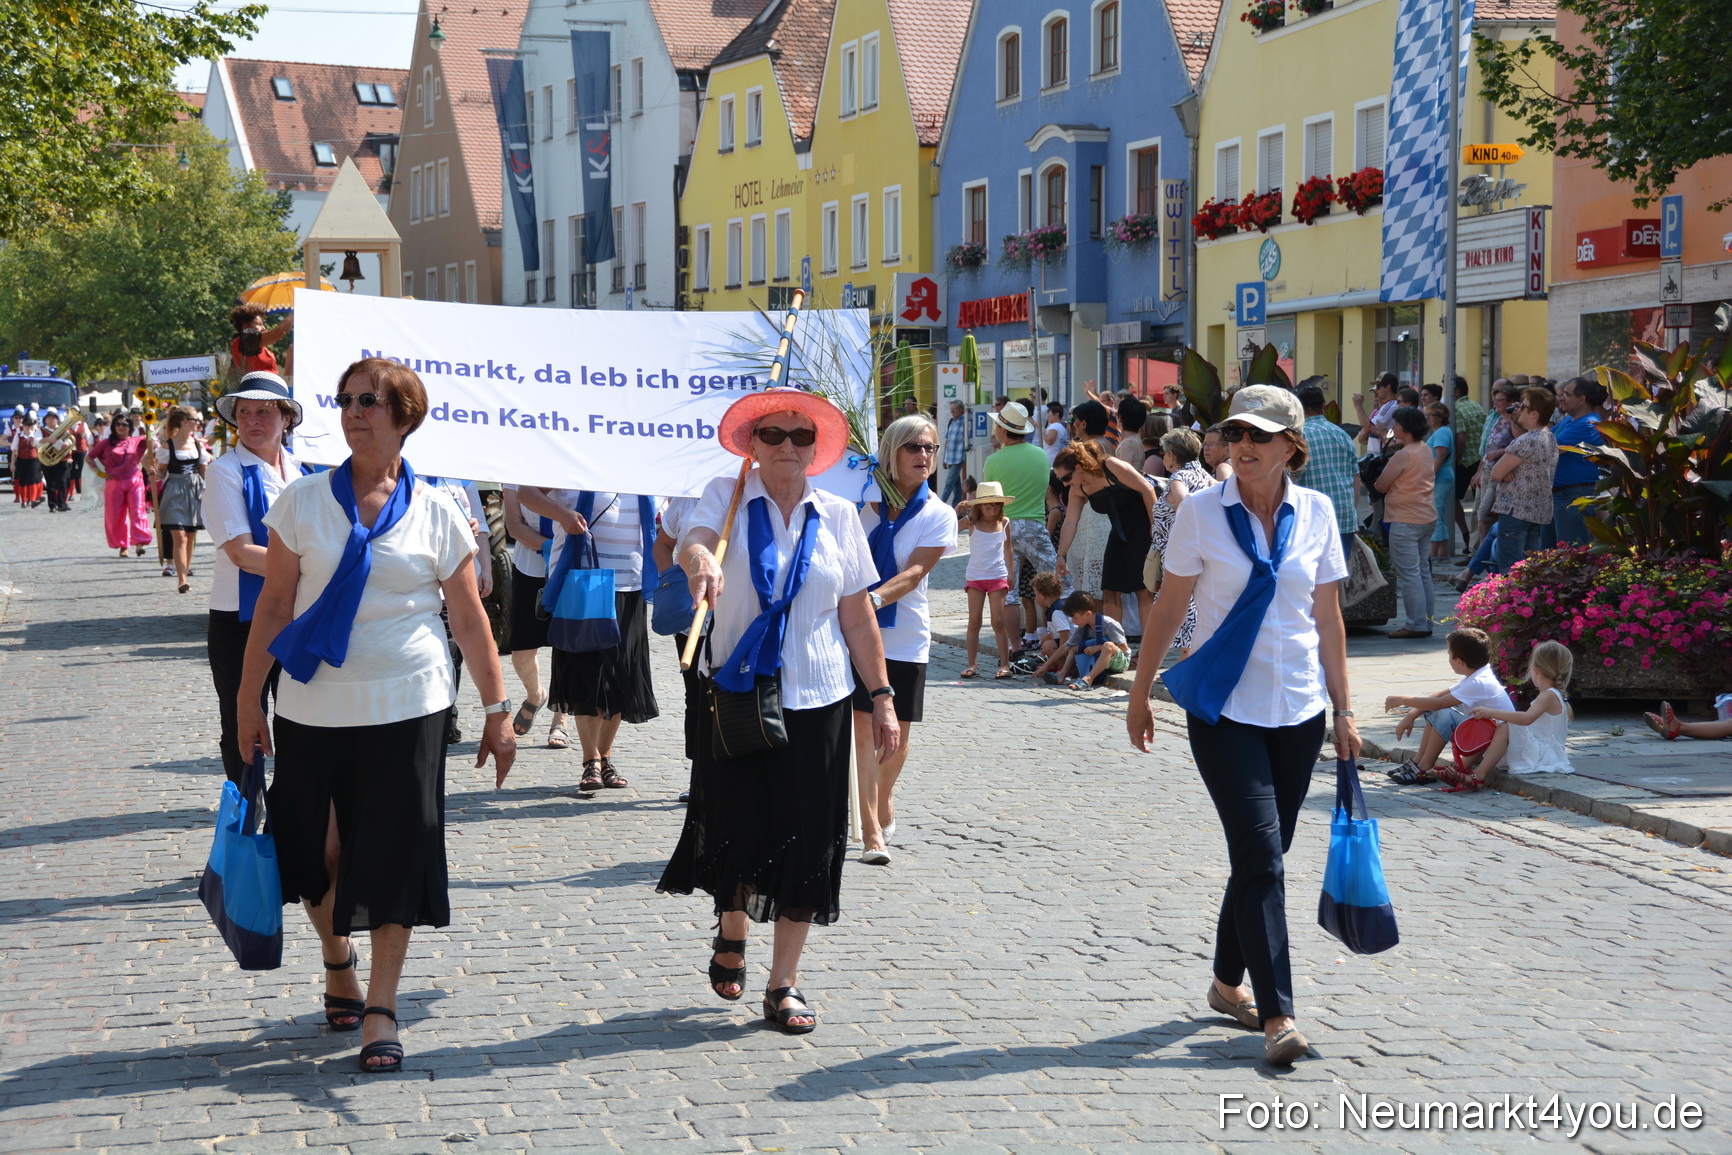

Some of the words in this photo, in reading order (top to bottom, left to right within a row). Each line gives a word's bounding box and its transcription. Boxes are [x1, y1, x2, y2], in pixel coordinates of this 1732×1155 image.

[1472, 148, 1498, 161] KINO
[734, 180, 763, 209] HOTEL
[770, 175, 804, 200] Lehmeier
[1632, 227, 1661, 245] DER
[1666, 204, 1677, 249] P
[1166, 203, 1183, 290] WITTL
[1466, 249, 1492, 267] RIALTO
[1495, 246, 1513, 264] KINO
[1531, 211, 1542, 291] KINO
[1577, 242, 1595, 262] DER
[957, 293, 1029, 328] APOTHEKE
[1243, 288, 1259, 321] P
[150, 365, 210, 376] Weiberfasching
[534, 364, 572, 384] da
[581, 366, 628, 387] leb
[636, 368, 679, 389] ich
[430, 402, 489, 425] den
[499, 408, 580, 432] Kath.
[588, 414, 720, 440] Frauenb
